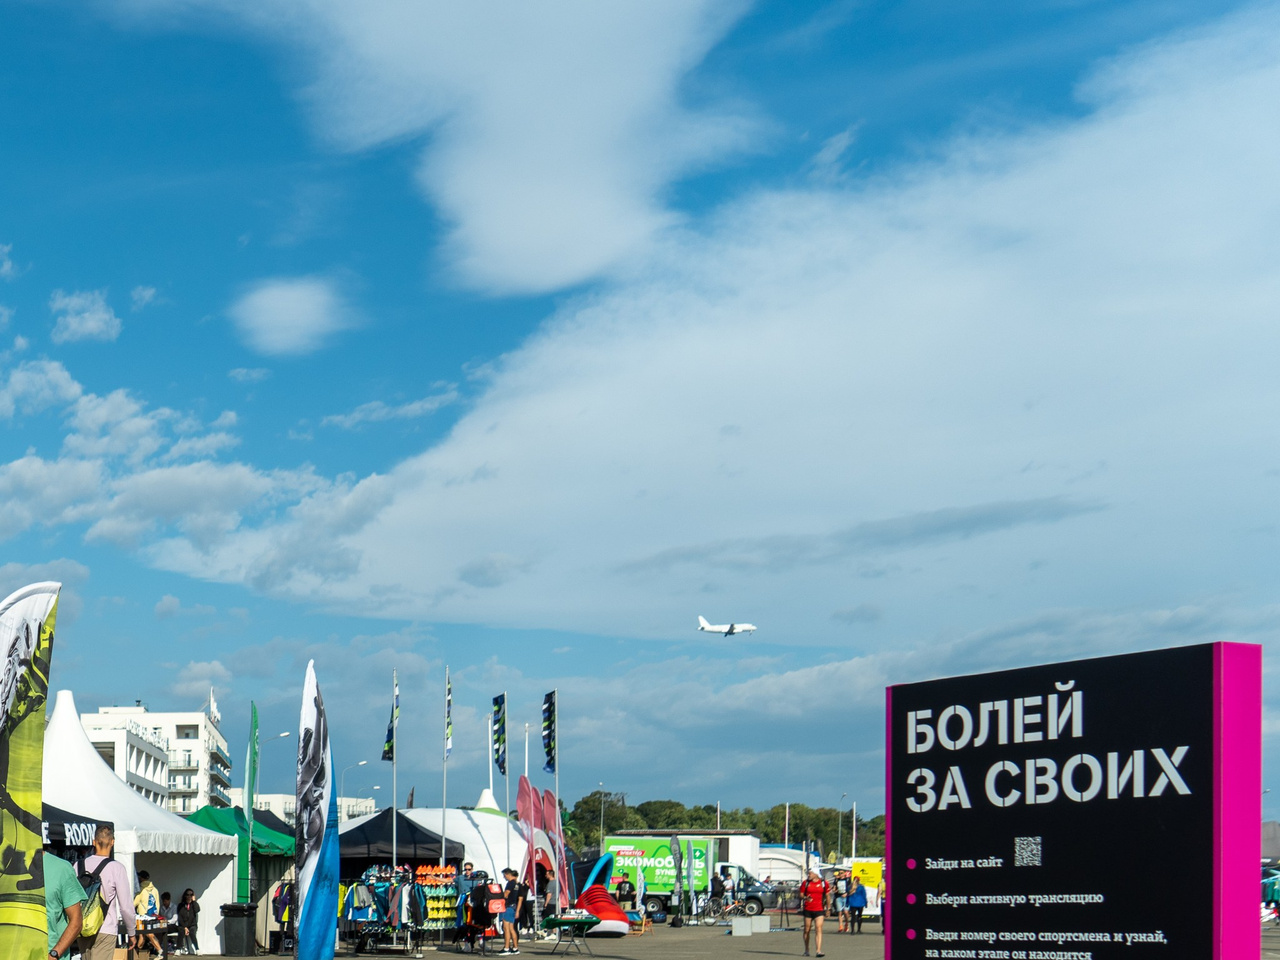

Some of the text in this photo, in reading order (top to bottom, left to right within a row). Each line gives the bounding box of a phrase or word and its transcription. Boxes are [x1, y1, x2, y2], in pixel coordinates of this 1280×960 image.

[907, 680, 1083, 754] БОЛЕЙ
[906, 745, 1192, 813] ЗА СВОИХ
[925, 856, 1003, 870] Зайди на сайт
[925, 892, 1104, 907] Выбери активную трансляцию
[925, 929, 1168, 945] Введи номер своего спортсмена и узнай,
[925, 949, 939, 958] на
[941, 950, 976, 959] каком
[978, 950, 1010, 959] этапе
[1012, 951, 1027, 960] он
